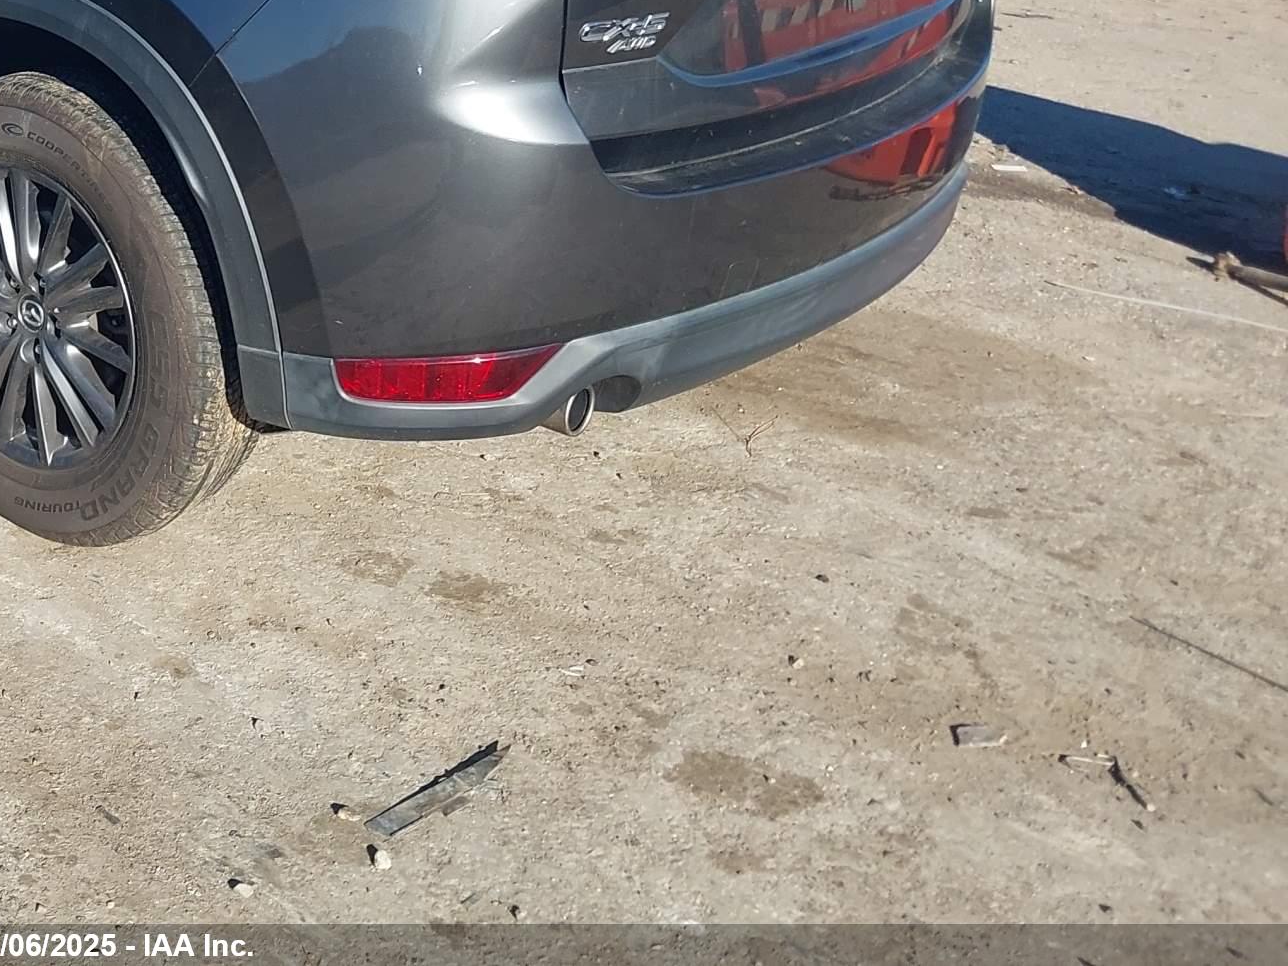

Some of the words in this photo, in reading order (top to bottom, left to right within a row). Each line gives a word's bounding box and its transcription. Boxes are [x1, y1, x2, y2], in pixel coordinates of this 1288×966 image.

[606, 34, 657, 54] AWD
[79, 422, 161, 521] GRAND
[14, 495, 81, 514] TOURING
